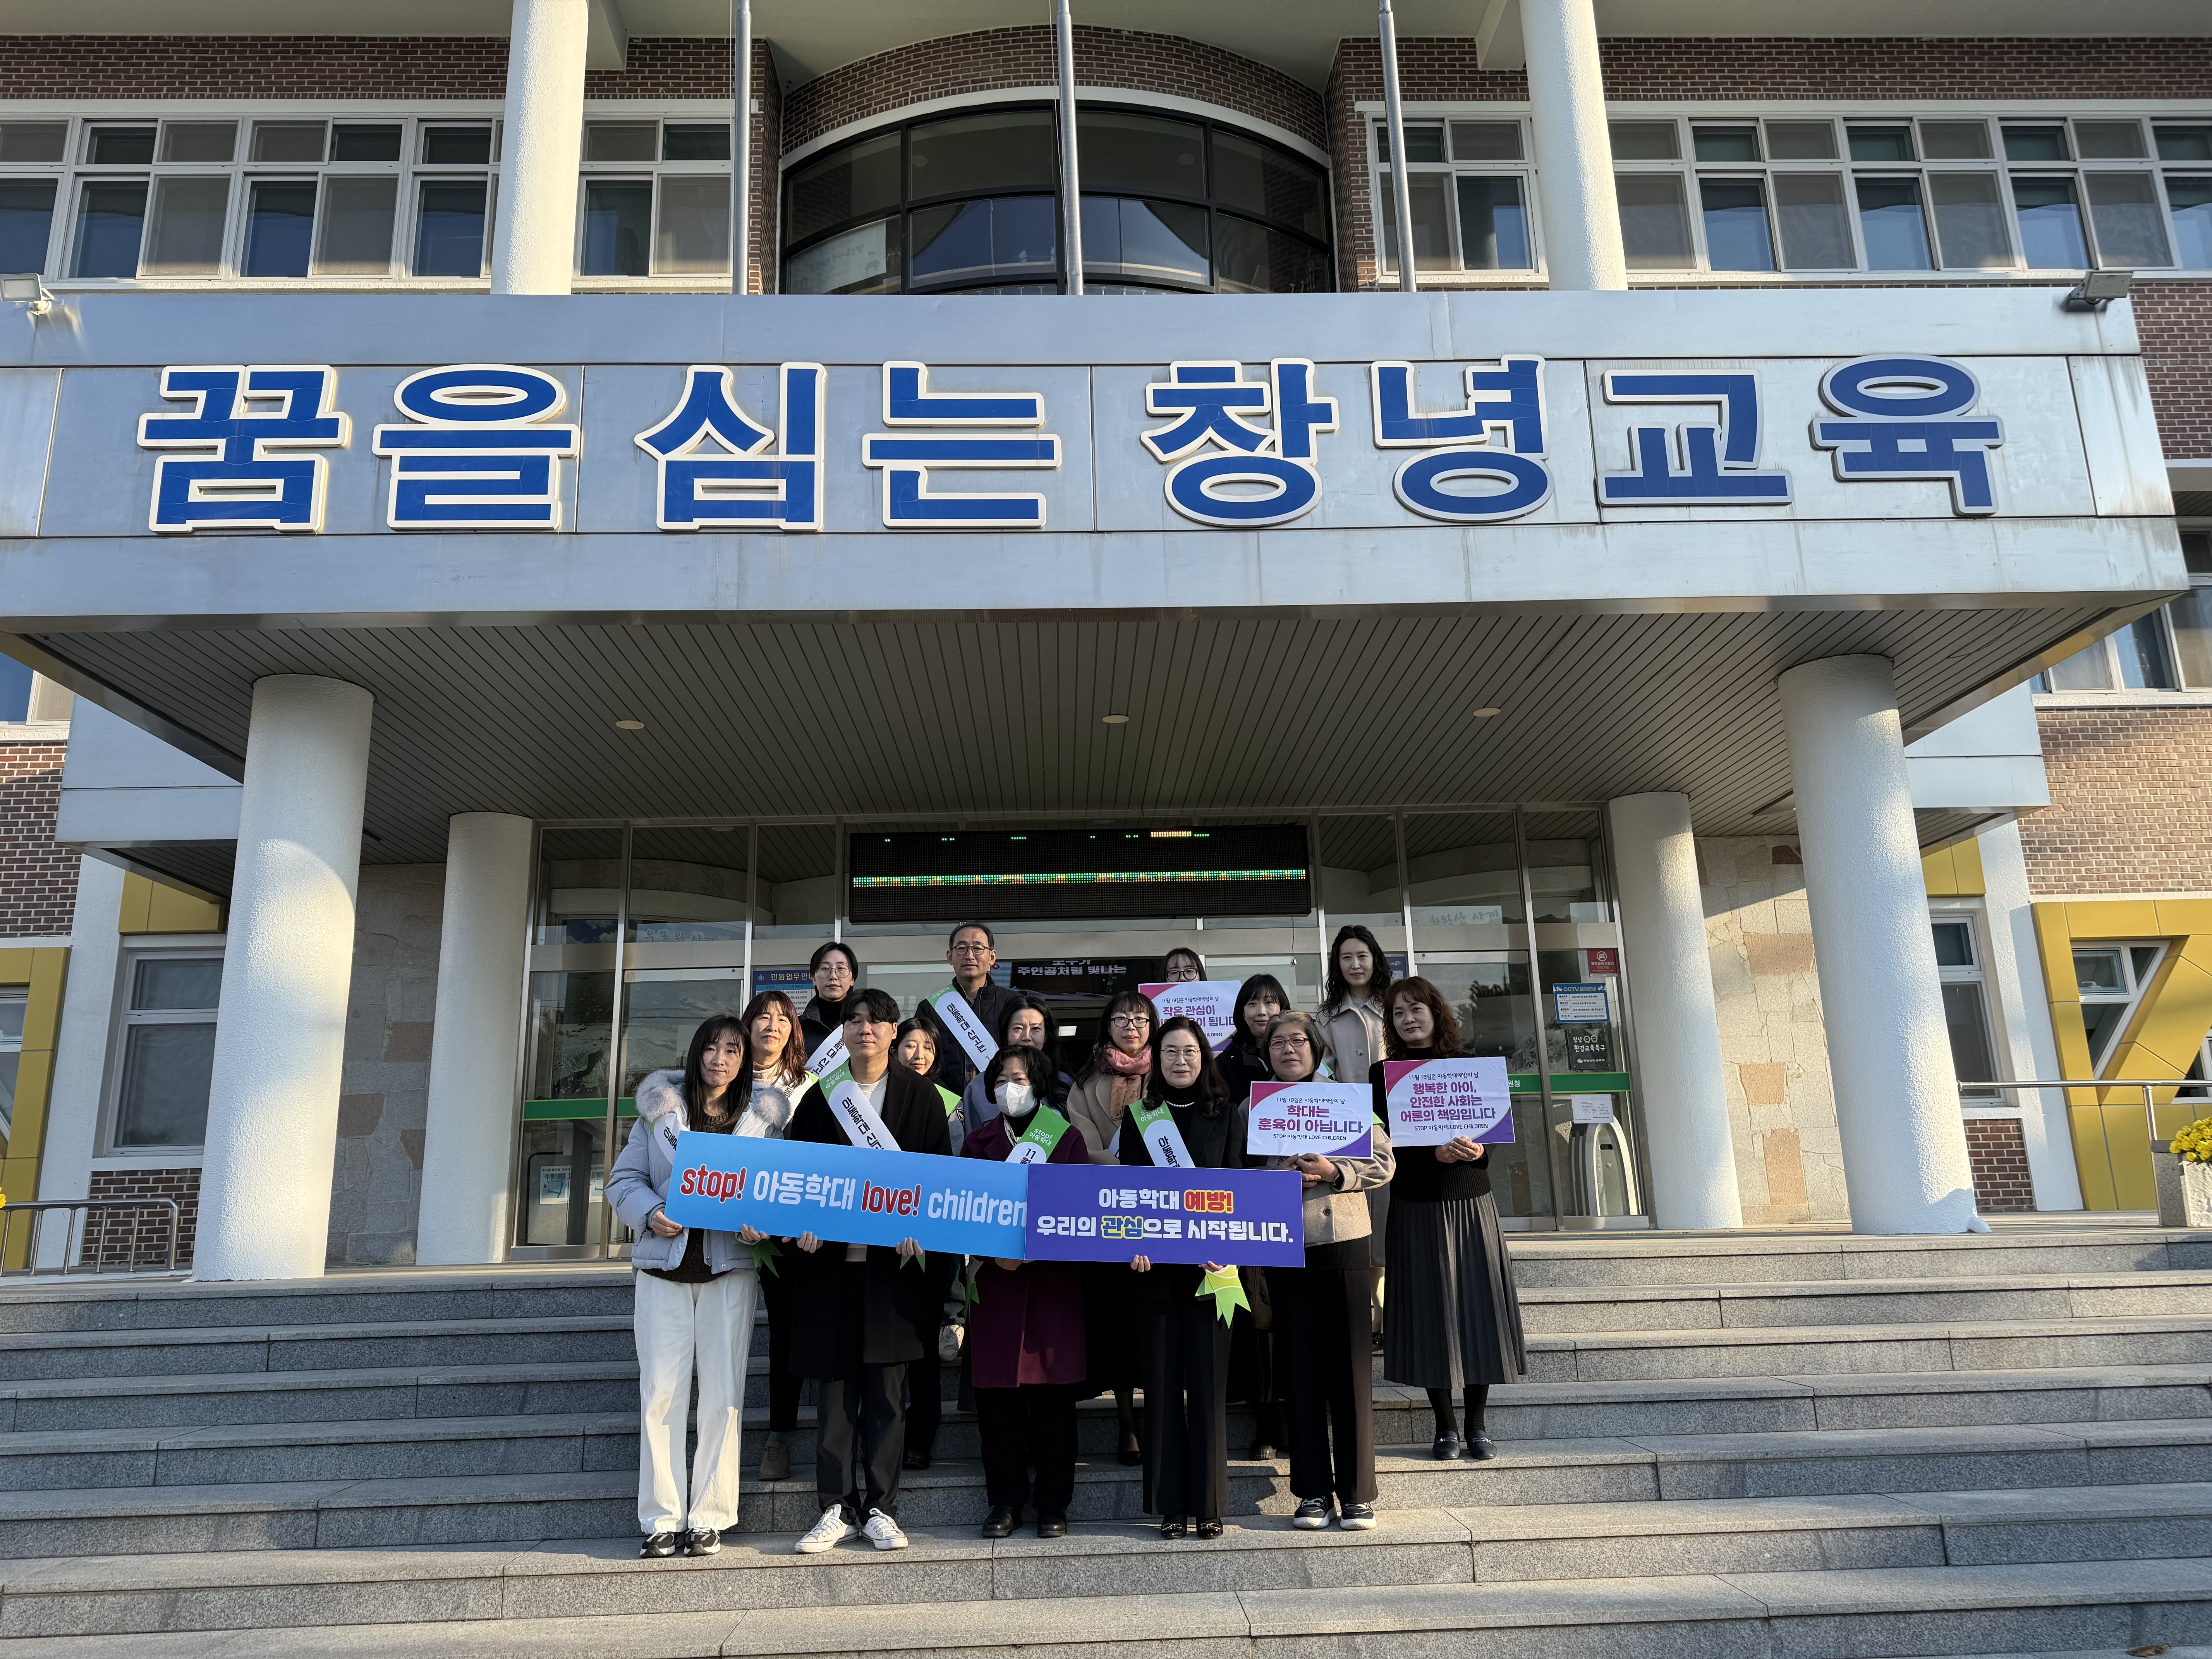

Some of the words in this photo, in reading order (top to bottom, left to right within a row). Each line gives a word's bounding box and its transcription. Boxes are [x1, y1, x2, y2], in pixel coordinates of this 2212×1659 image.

[137, 363, 582, 534] 꿈을
[634, 361, 1061, 533] 심는
[1140, 353, 2005, 528] 창녕교육
[1018, 966, 1083, 975] 주인공처럼
[1088, 965, 1127, 974] 빛나는
[947, 1003, 970, 1031] 아동학대
[1163, 1006, 1183, 1016] 작은
[1185, 1005, 1215, 1016] 관심이
[1574, 1044, 1606, 1052] 환경교육특구
[1413, 1082, 1448, 1095] 행복한
[1450, 1081, 1477, 1094] 아이,
[1410, 1096, 1445, 1108] 안전한
[1448, 1094, 1482, 1107] 사회는
[1287, 1105, 1330, 1118] 학대는
[1400, 1109, 1434, 1122] 어른의
[1437, 1107, 1496, 1121] 책임입니다
[1258, 1118, 1300, 1132] 훈육이
[1305, 1120, 1363, 1134] 아닙니다
[1029, 1132, 1052, 1147] 아동학대
[1034, 1128, 1053, 1140] stop!
[680, 1163, 747, 1204] stop!
[753, 1170, 856, 1211] 아동학대
[860, 1179, 922, 1217] love!
[927, 1187, 1027, 1228] children
[1099, 1188, 1180, 1210] 아동학대
[1183, 1189, 1234, 1214] 예방!
[1037, 1216, 1097, 1237] 우리의
[1101, 1215, 1182, 1240] 관심으로
[1187, 1219, 1294, 1243] 시작됩니다.
